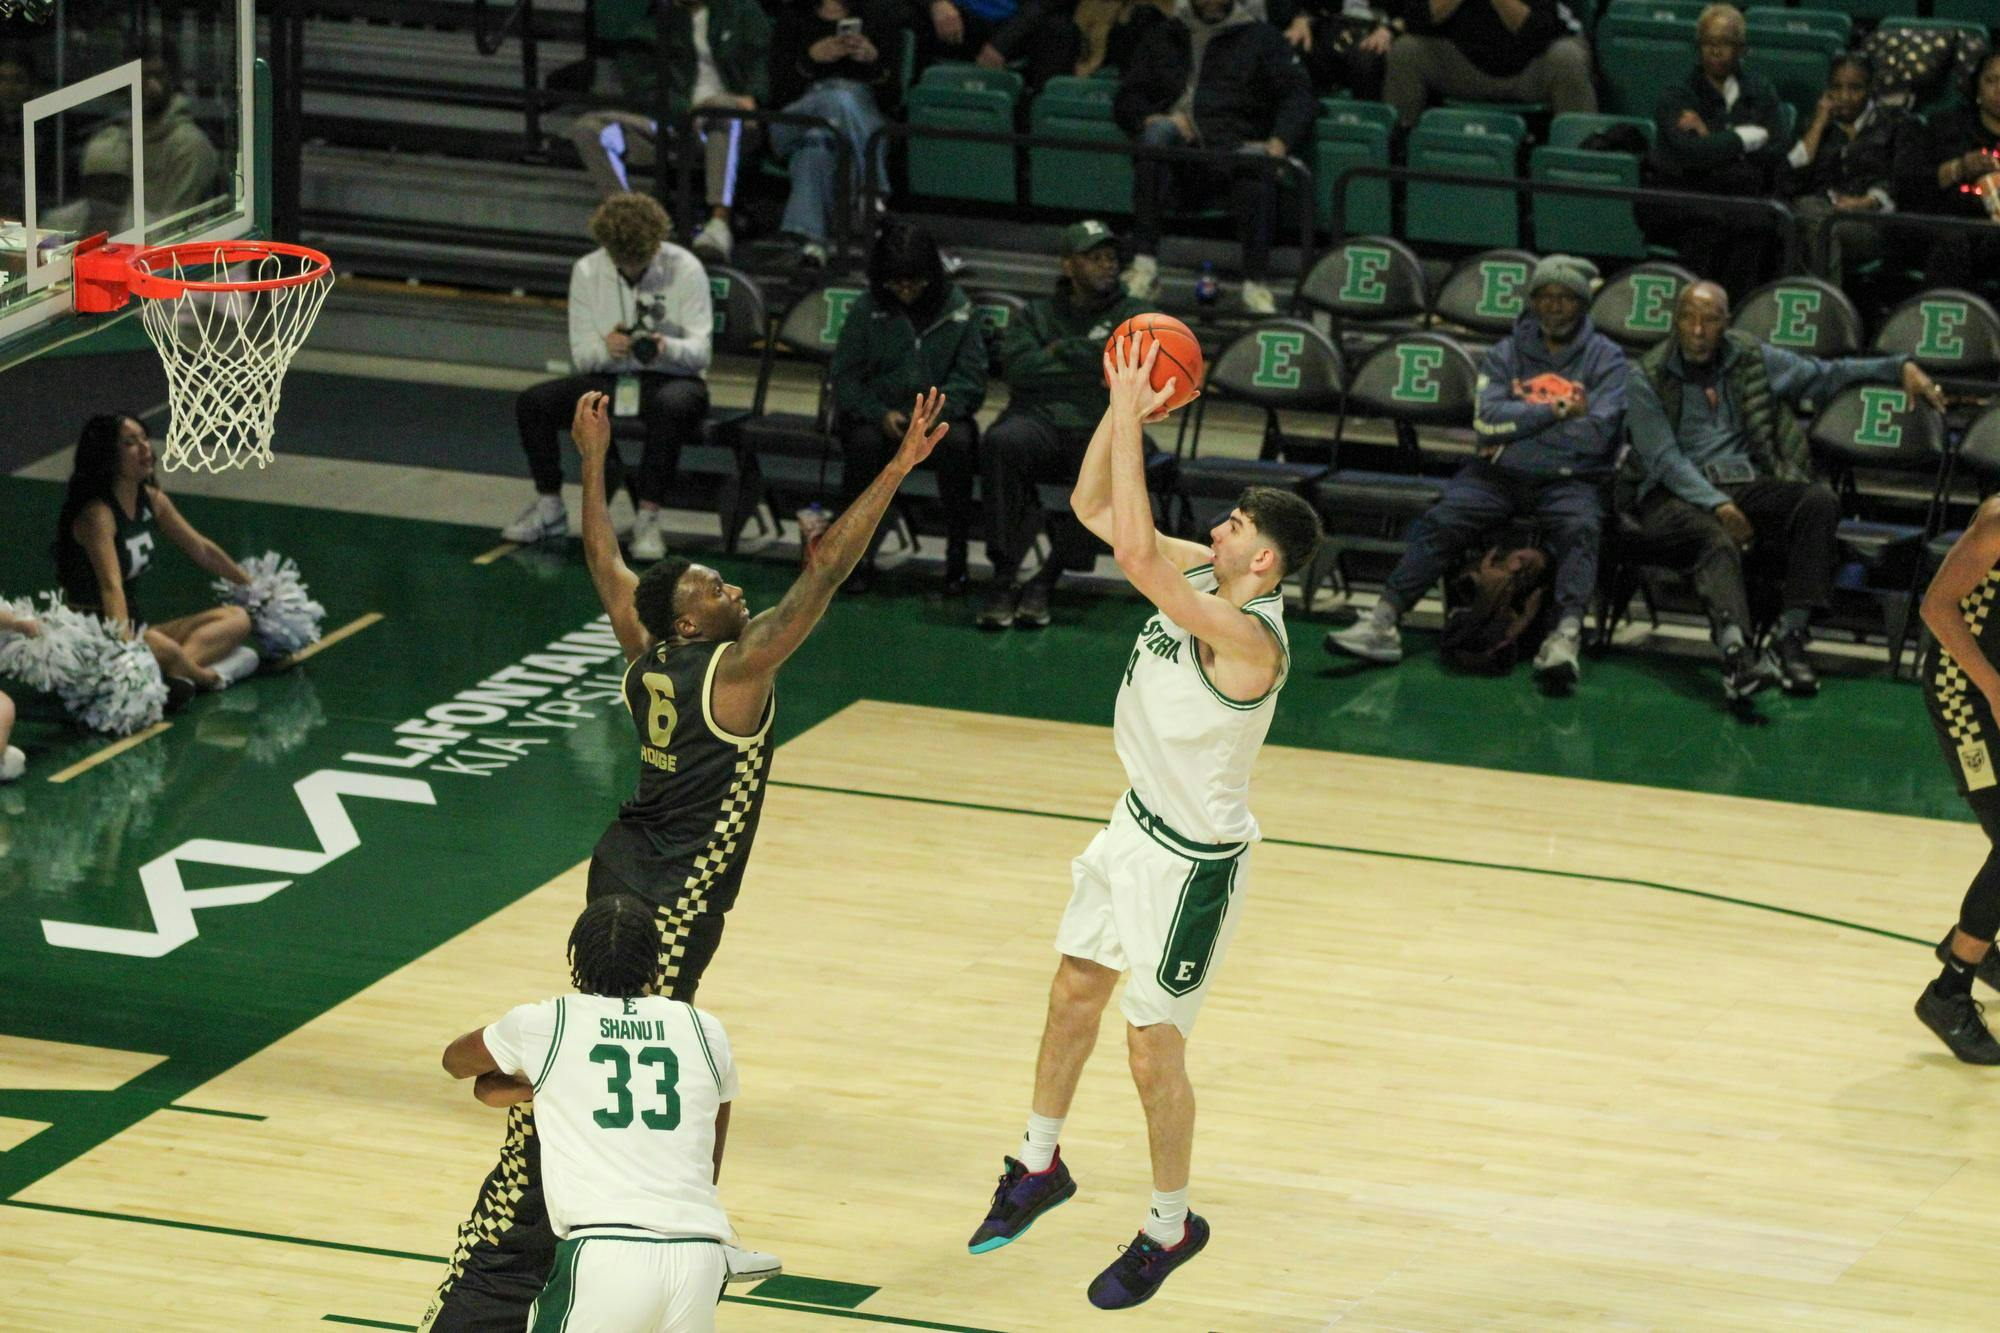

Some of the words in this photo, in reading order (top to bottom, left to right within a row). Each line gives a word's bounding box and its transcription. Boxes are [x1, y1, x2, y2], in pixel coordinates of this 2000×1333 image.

[1340, 246, 1390, 303] E
[1476, 261, 1526, 318] E
[1625, 274, 1676, 332] E
[1770, 289, 1821, 347] E
[1916, 302, 1967, 359] E
[1253, 331, 1304, 389] E
[1392, 344, 1443, 403] E
[1854, 387, 1905, 447] E
[342, 613, 624, 768] LAFONTAIN
[642, 672, 678, 748] 6
[430, 738, 549, 777] KIA
[1175, 960, 1196, 981] E
[600, 1017, 653, 1041] SHANU
[655, 1020, 665, 1041] II
[622, 998, 638, 1015] E
[588, 1043, 682, 1131] 33
